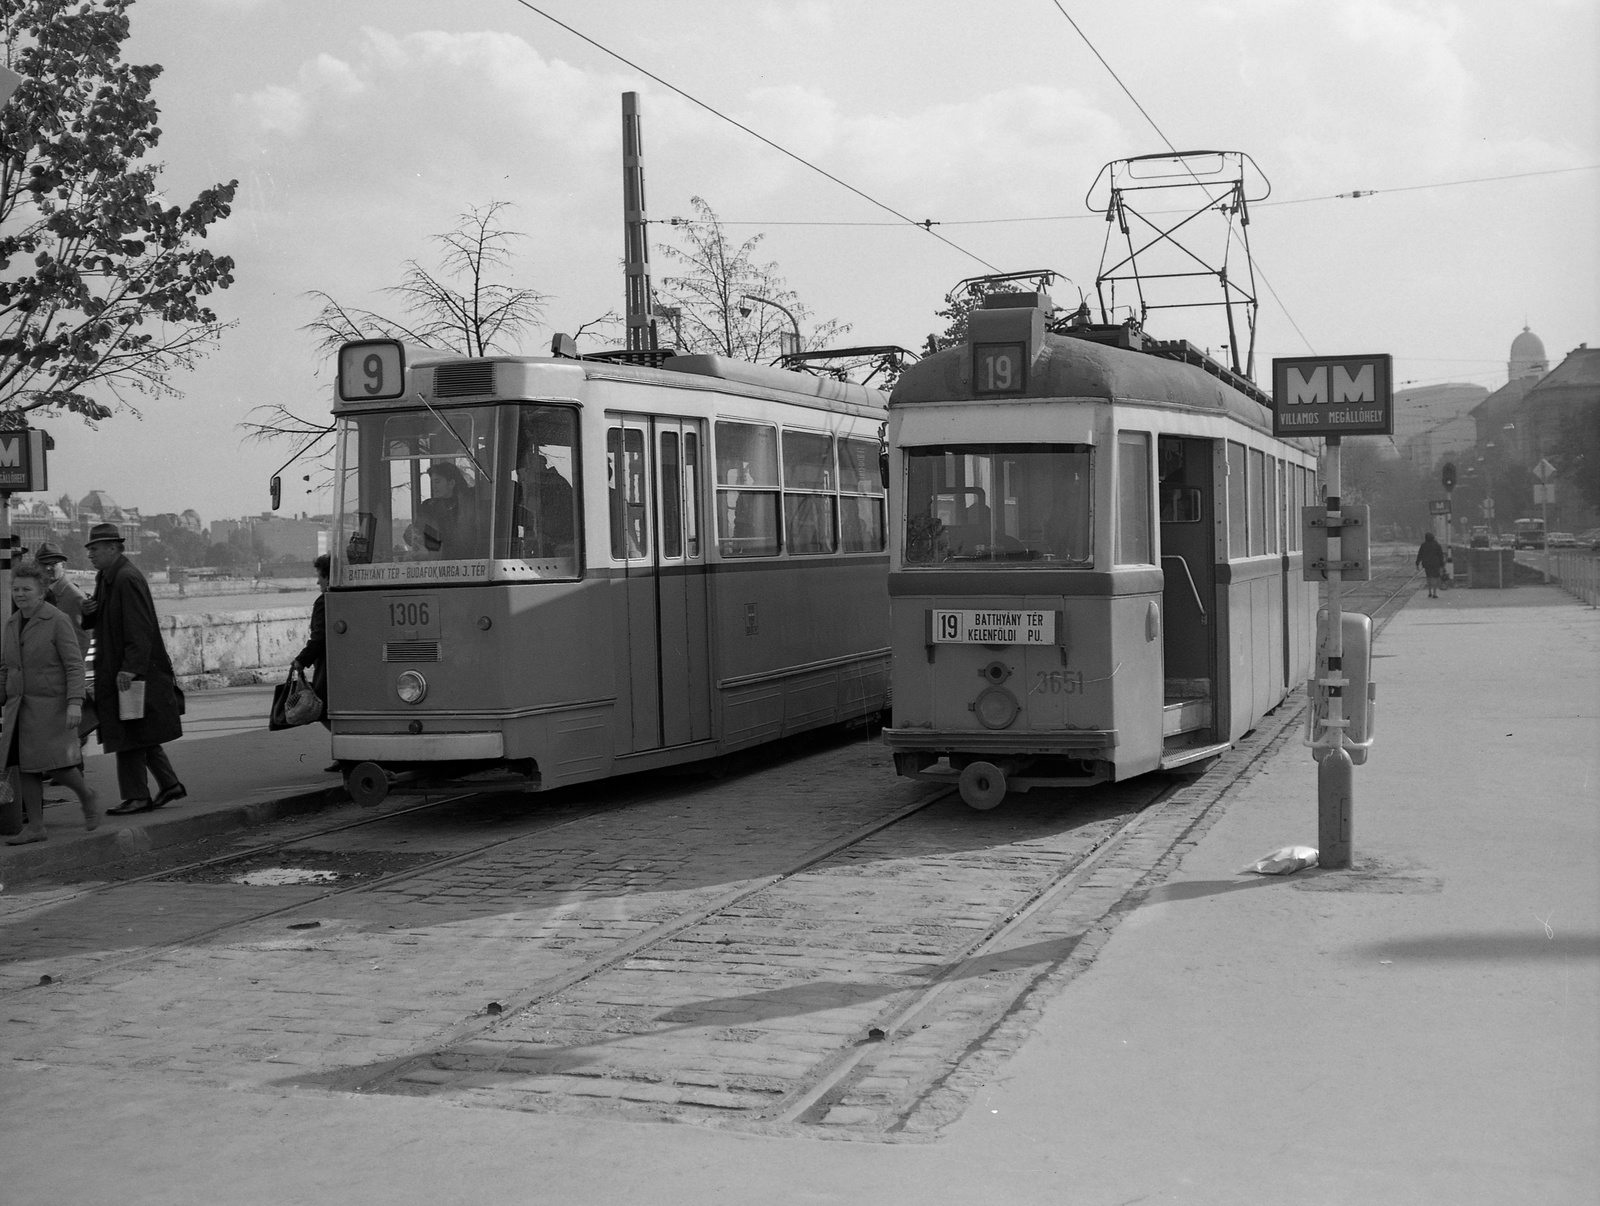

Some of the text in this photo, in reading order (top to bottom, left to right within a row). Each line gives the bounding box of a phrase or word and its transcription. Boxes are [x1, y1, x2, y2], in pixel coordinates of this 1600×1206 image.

[364, 354, 383, 395] 9
[986, 355, 1012, 390] 19
[1280, 407, 1384, 425] VILLAMOS MEGÁLLÓHELY
[462, 565, 470, 577] J.
[471, 562, 486, 577] TÉR
[389, 602, 430, 627] 1306
[941, 614, 958, 639] 19
[975, 612, 1043, 626] BATTHYÁNY TÉR
[968, 627, 1043, 642] KELENFÖLDI PU.
[1036, 670, 1084, 695] 3651
